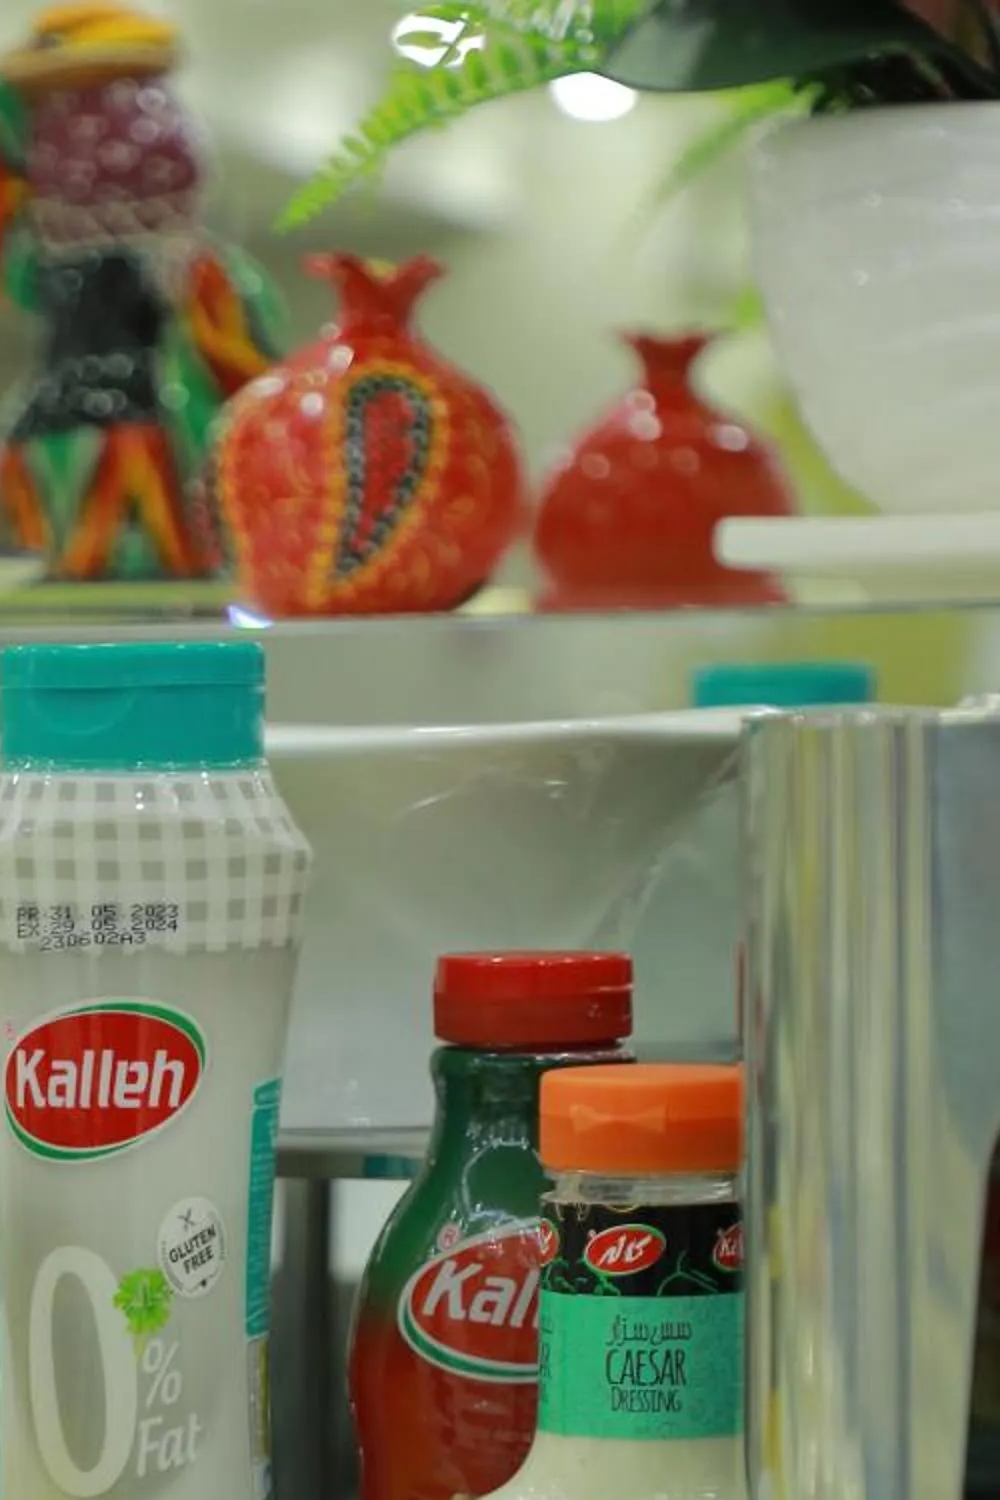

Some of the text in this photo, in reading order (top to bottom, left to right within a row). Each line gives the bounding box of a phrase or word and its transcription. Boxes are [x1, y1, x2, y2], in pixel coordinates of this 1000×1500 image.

[15, 1049, 185, 1108] Kalleh
[168, 1223, 217, 1264] GLUTEN
[182, 1244, 216, 1275] FREE
[422, 1259, 539, 1328] Kal
[606, 1348, 688, 1387] CAESAR
[611, 1386, 683, 1413] DRESSING
[136, 1412, 201, 1478] Fat
